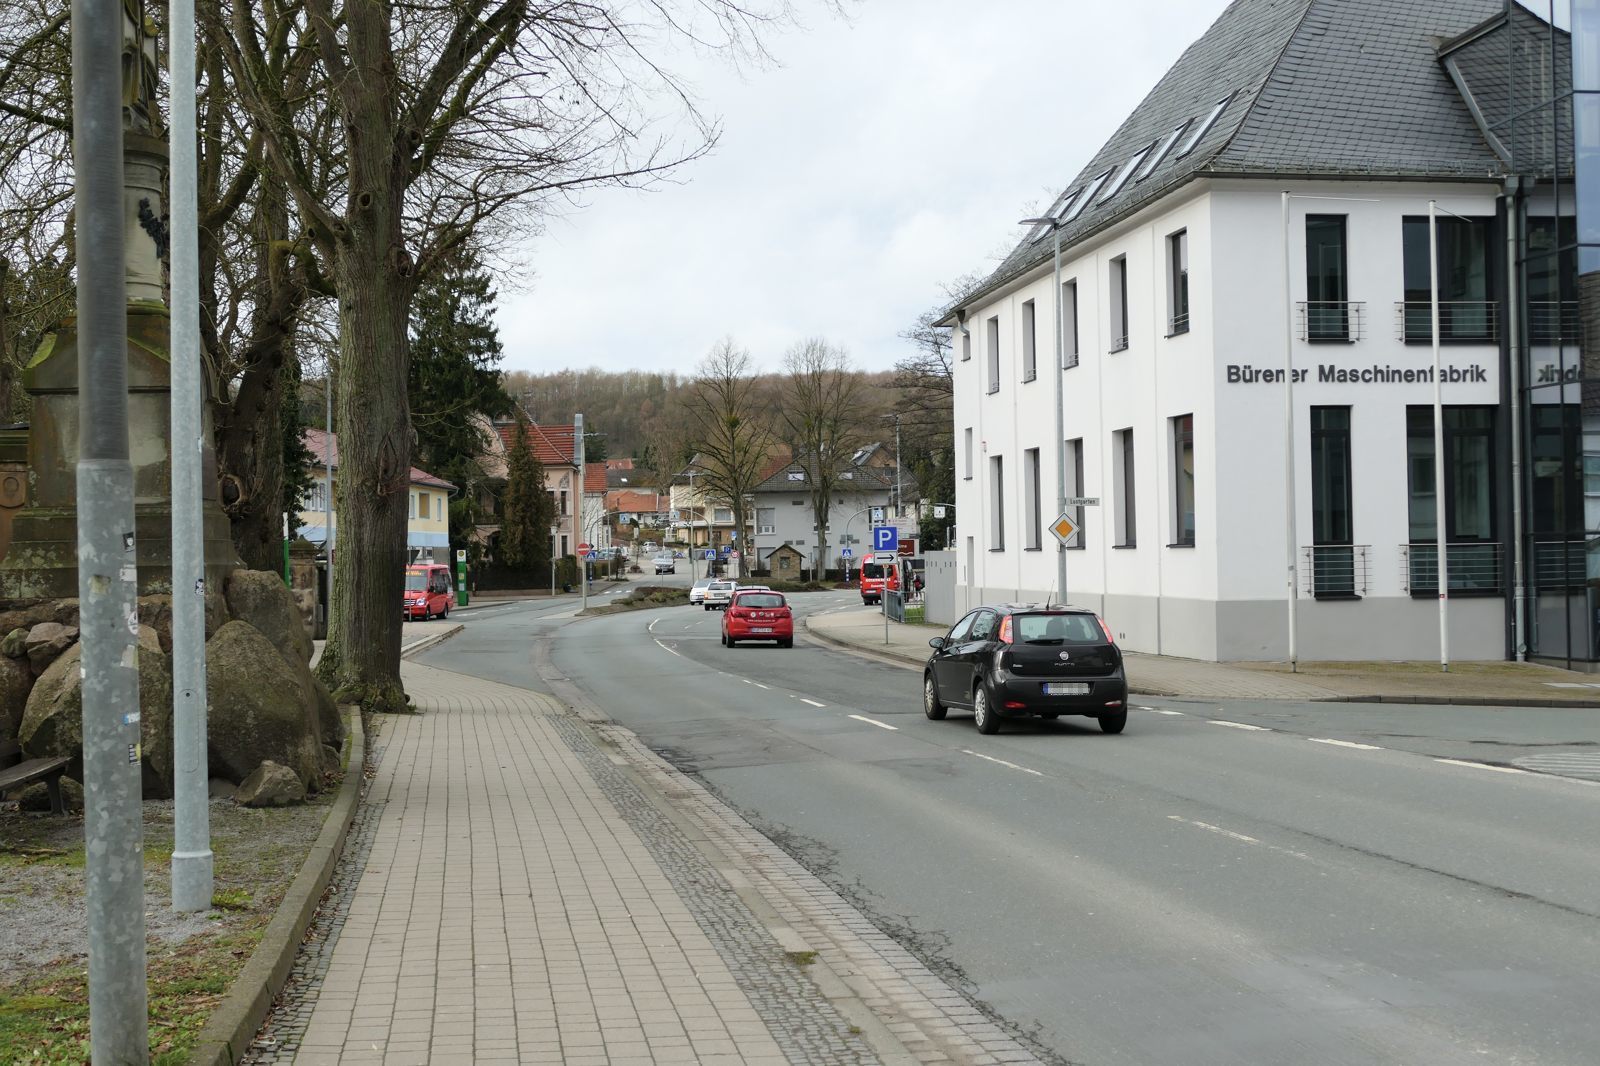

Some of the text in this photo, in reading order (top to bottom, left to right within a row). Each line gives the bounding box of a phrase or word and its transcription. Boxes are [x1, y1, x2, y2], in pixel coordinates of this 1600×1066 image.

[1226, 364, 1488, 383] Bürener Maschinenfabrik
[878, 529, 892, 548] P
